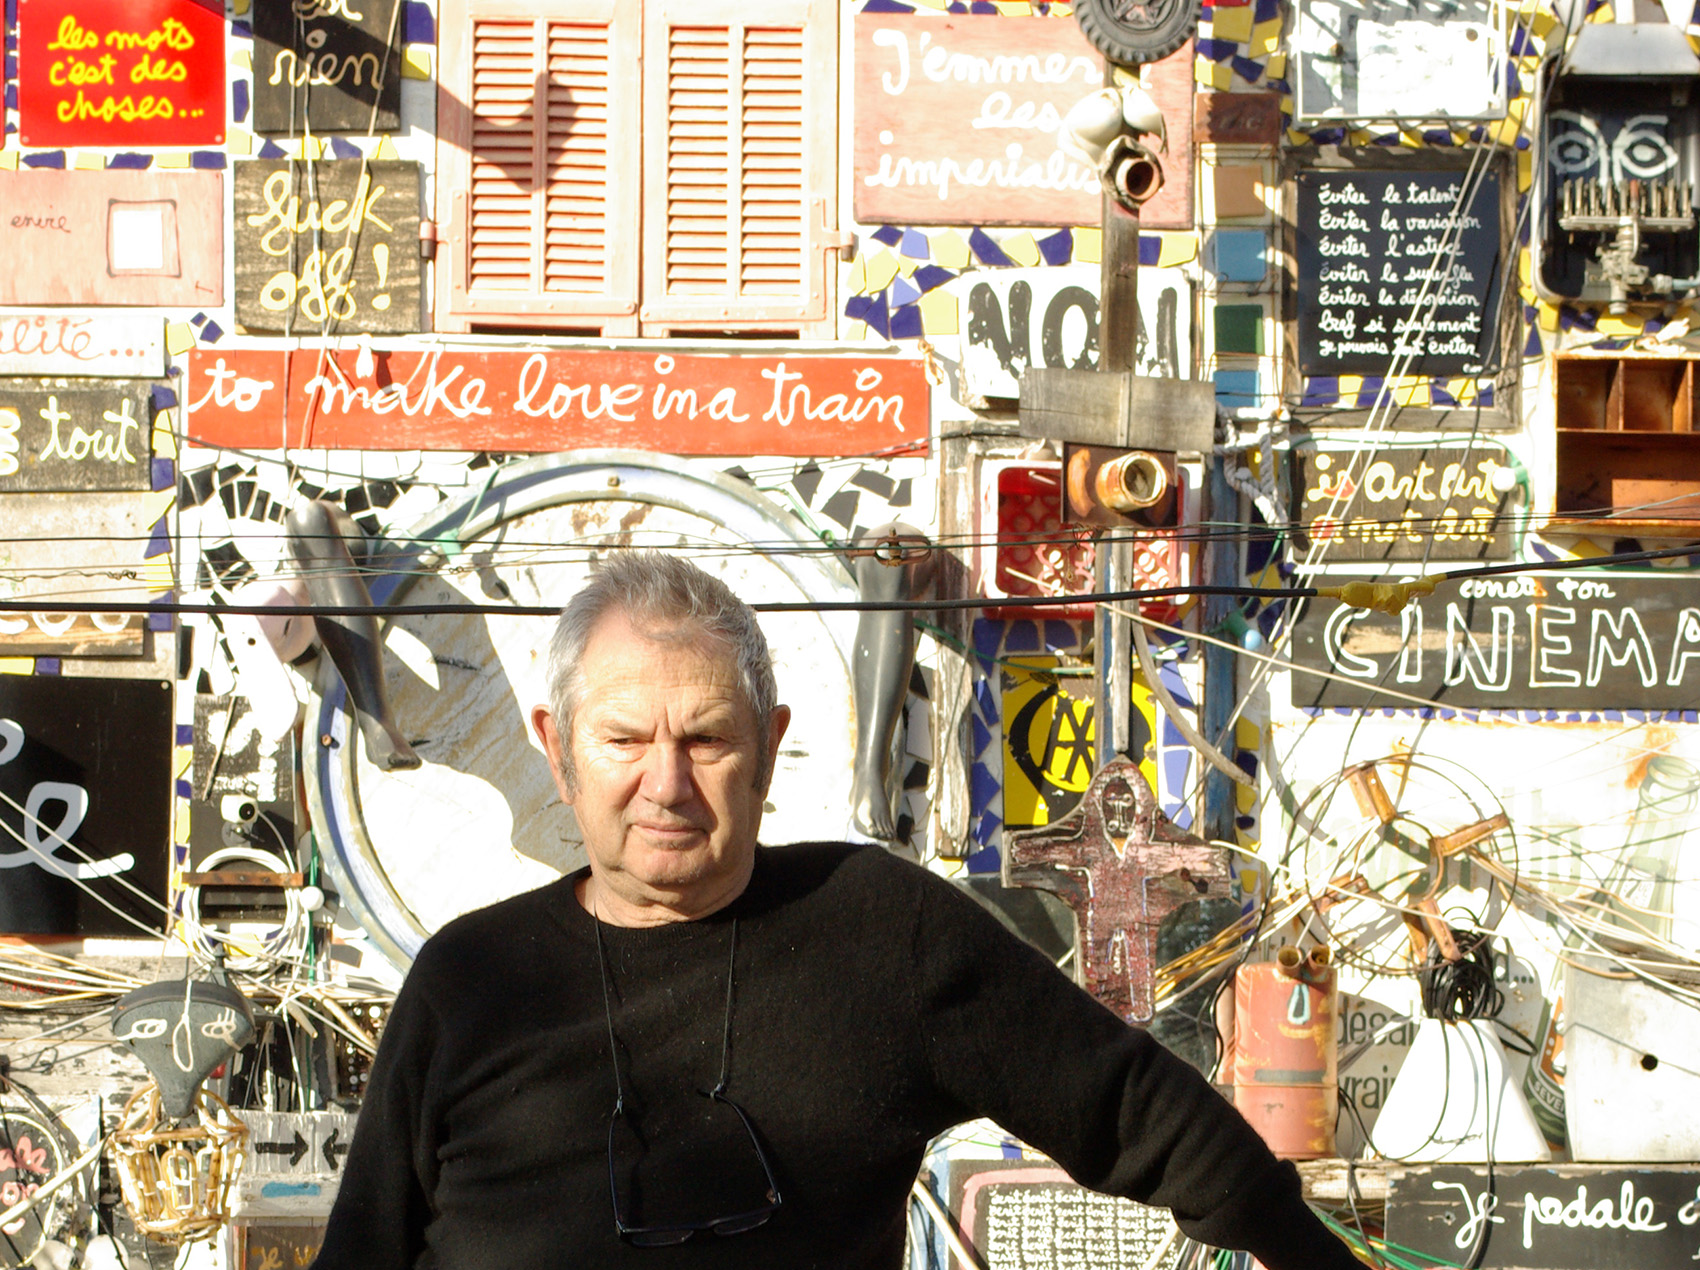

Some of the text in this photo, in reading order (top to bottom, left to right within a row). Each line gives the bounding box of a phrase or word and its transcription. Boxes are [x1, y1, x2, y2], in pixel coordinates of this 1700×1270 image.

[48, 15, 194, 51] les mots
[50, 56, 187, 86] c'est des
[268, 29, 384, 90] rien
[1382, 183, 1402, 204] le
[1407, 182, 1461, 204] talent
[247, 170, 392, 255] fuck
[1380, 208, 1400, 231] la
[1406, 210, 1481, 232] variation
[1380, 262, 1399, 283] le
[1403, 264, 1474, 289] superflu
[1378, 287, 1396, 306] la
[1364, 315, 1386, 333] si
[1392, 312, 1481, 333] seulement
[188, 358, 274, 413] to
[304, 365, 492, 418] make
[513, 353, 642, 423] love
[699, 387, 750, 423] a
[762, 362, 905, 432] train
[40, 396, 138, 463] tout
[1556, 577, 1616, 600] ton
[1324, 600, 1700, 691] CINEMA
[1523, 1180, 1667, 1249] pedale
